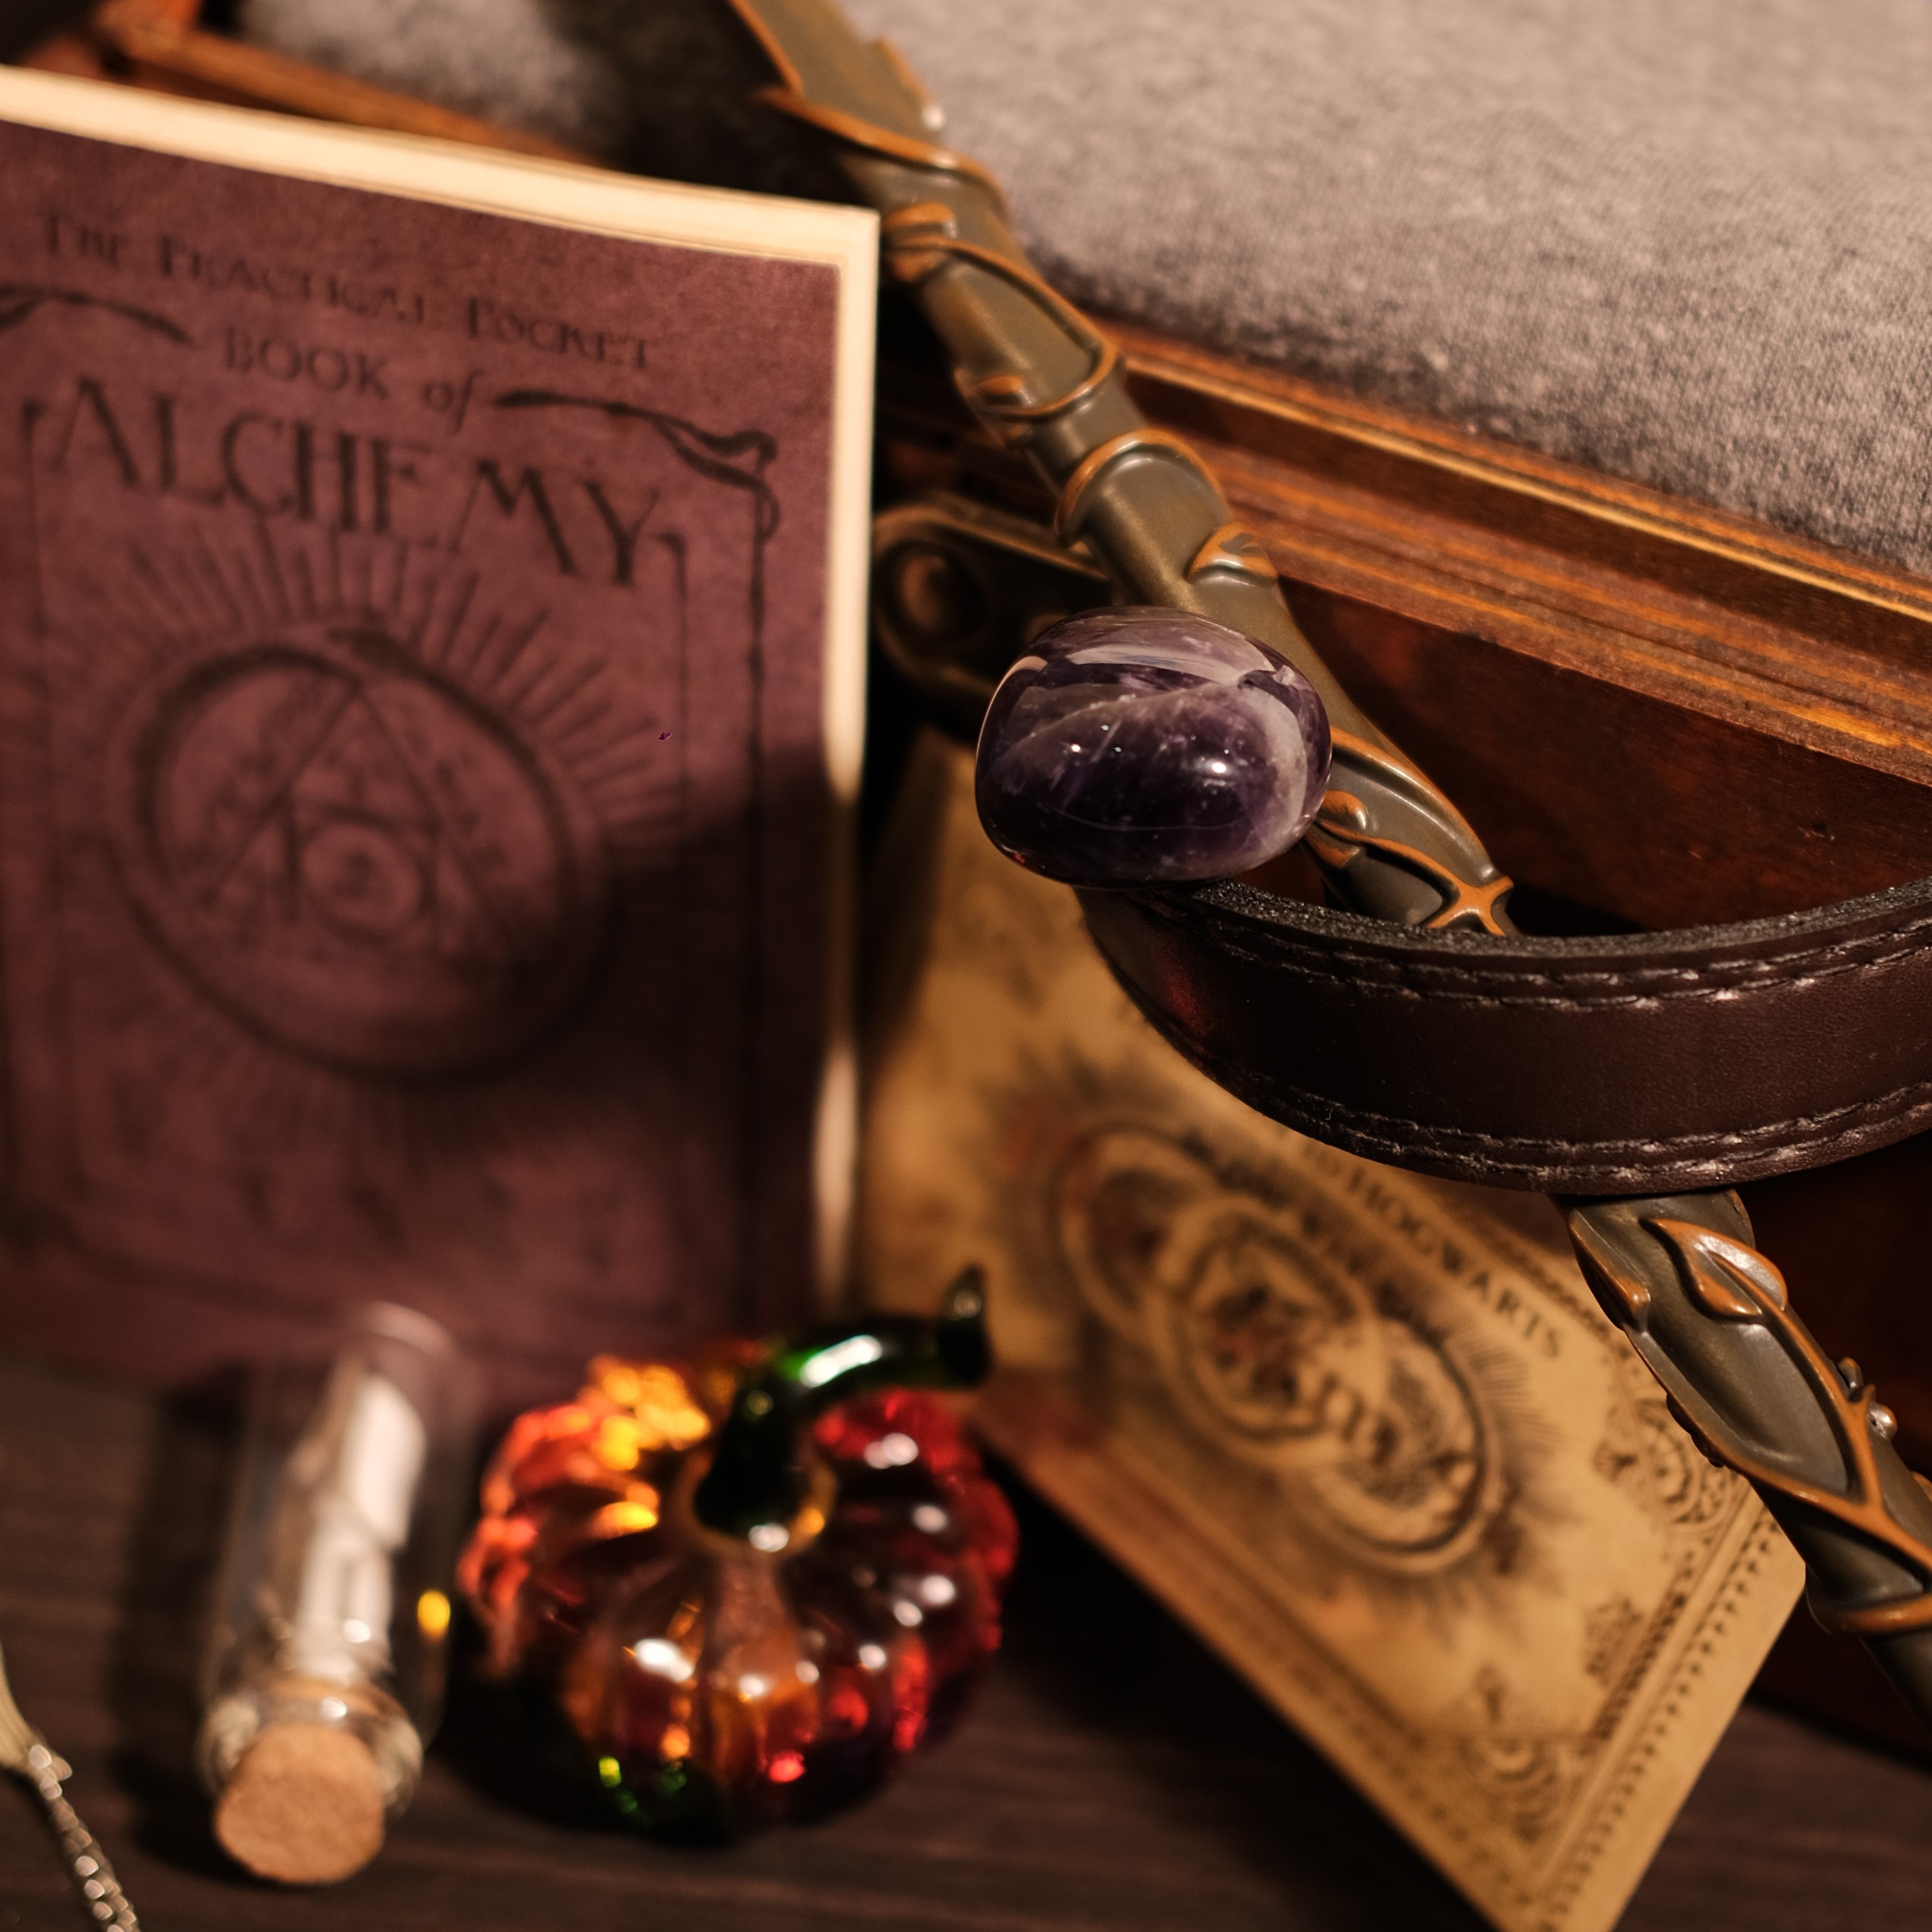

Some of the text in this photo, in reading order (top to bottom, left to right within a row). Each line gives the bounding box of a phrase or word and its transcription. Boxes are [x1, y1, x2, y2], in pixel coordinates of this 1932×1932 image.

[223, 328, 482, 435] BOOK of
[51, 374, 664, 587] ALCHEMY
[1346, 1163, 1561, 1360] HOGWARTS
